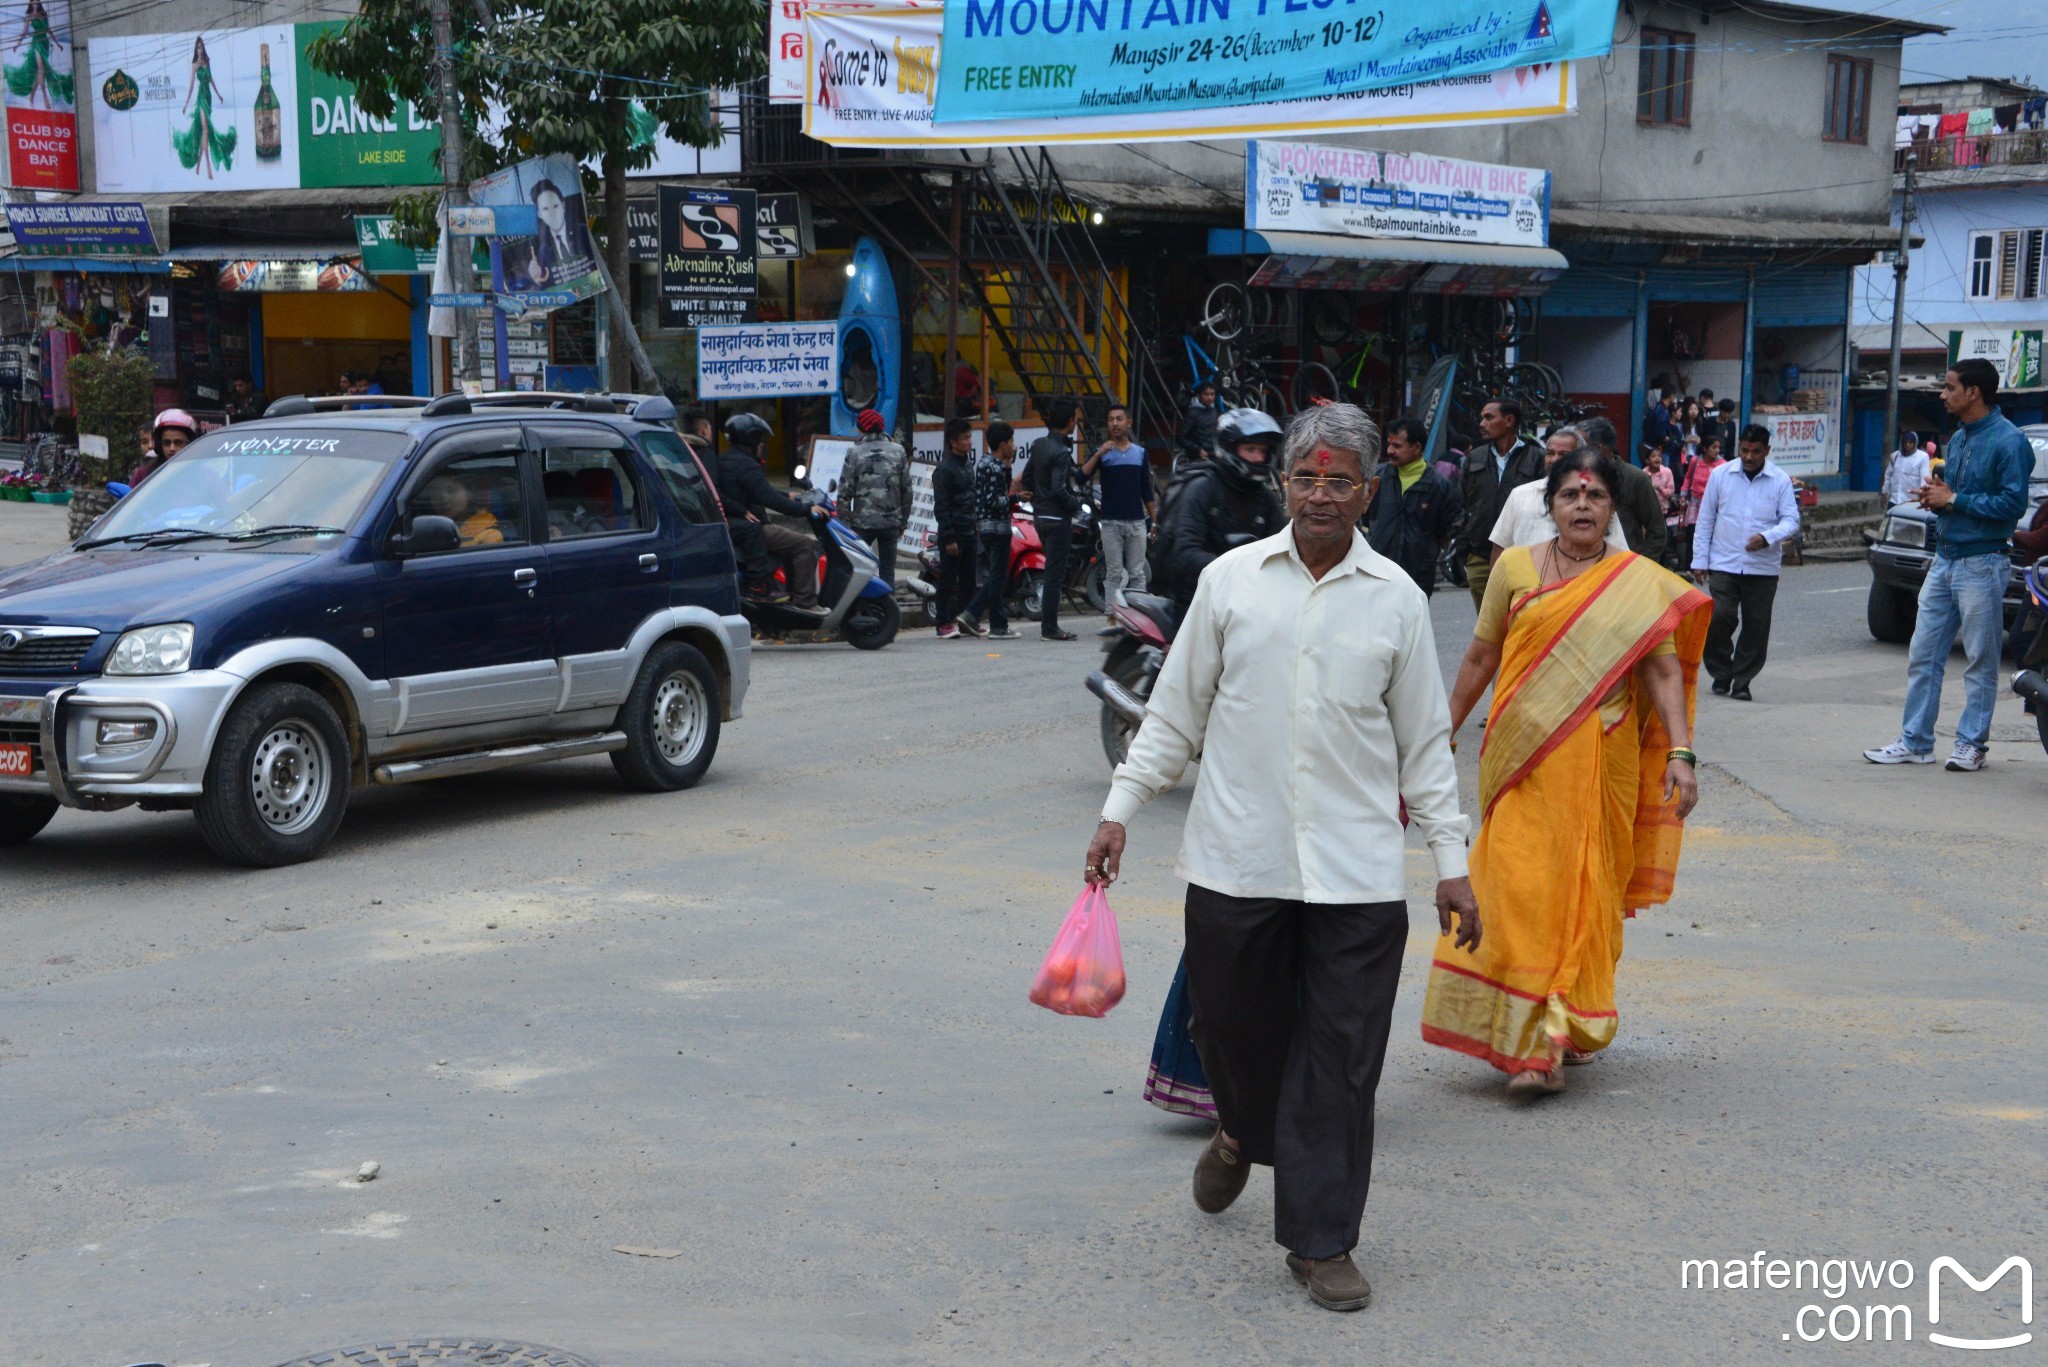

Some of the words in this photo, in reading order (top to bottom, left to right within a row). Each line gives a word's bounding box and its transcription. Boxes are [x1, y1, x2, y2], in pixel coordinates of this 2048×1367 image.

[1404, 16, 1481, 49] Organized
[1110, 42, 1184, 74] Mangsir
[1322, 10, 1384, 47] 10-12)
[1526, 39, 1545, 48] NMA
[893, 35, 935, 106] busy
[1323, 64, 1363, 91] Nepal
[1366, 50, 1450, 78] Mountaineering
[1450, 39, 1518, 65] Association
[148, 76, 162, 87] MAKE
[163, 75, 171, 86] AN
[964, 66, 1012, 92] FREE
[1018, 64, 1077, 89] ENTRY
[1416, 78, 1441, 88] NEPAL
[1441, 74, 1492, 86] VOLUNTEERS
[144, 88, 177, 101] IMPRESSION
[1079, 84, 1142, 107] International
[1143, 80, 1187, 102] Mountain
[1336, 90, 1365, 100] AND
[834, 108, 852, 121] FREE
[882, 109, 902, 121] LIVE
[12, 123, 51, 137] CLUB
[53, 127, 71, 138] 99
[18, 138, 68, 153] DANCE
[29, 153, 59, 167] BAR
[358, 151, 382, 164] LAKE
[383, 150, 406, 163] SIDE
[1279, 145, 1381, 180] POKHARA
[1384, 154, 1483, 190] MOUNTAIN
[1488, 167, 1528, 196] BIKE
[1270, 176, 1290, 185] CENTER
[1304, 185, 1318, 198] Tour
[1361, 190, 1392, 204] Accessories
[1396, 193, 1414, 205] School
[1420, 195, 1434, 207] Social
[1434, 196, 1448, 208] Work
[1452, 198, 1479, 212] Recreational
[1479, 201, 1508, 215] Opportunities
[7, 206, 37, 223] WOMEN
[36, 206, 70, 223] SUNRISE
[67, 206, 116, 223] HANDICRAFT
[113, 206, 146, 223] CENTER
[468, 216, 490, 226] Ncell
[1343, 215, 1478, 238] www.nepalmountainbike.com
[664, 254, 724, 274] Adrenaline
[725, 255, 754, 276] Rush
[690, 276, 734, 285] NEPAL
[664, 285, 755, 294] www.adrenalinenepal.com
[457, 295, 483, 306] Temple
[670, 299, 706, 311] WHITE
[708, 300, 747, 312] WATER
[687, 313, 743, 326] SPECIALIST
[766, 328, 791, 353] सेवा
[803, 352, 830, 377] सेवा
